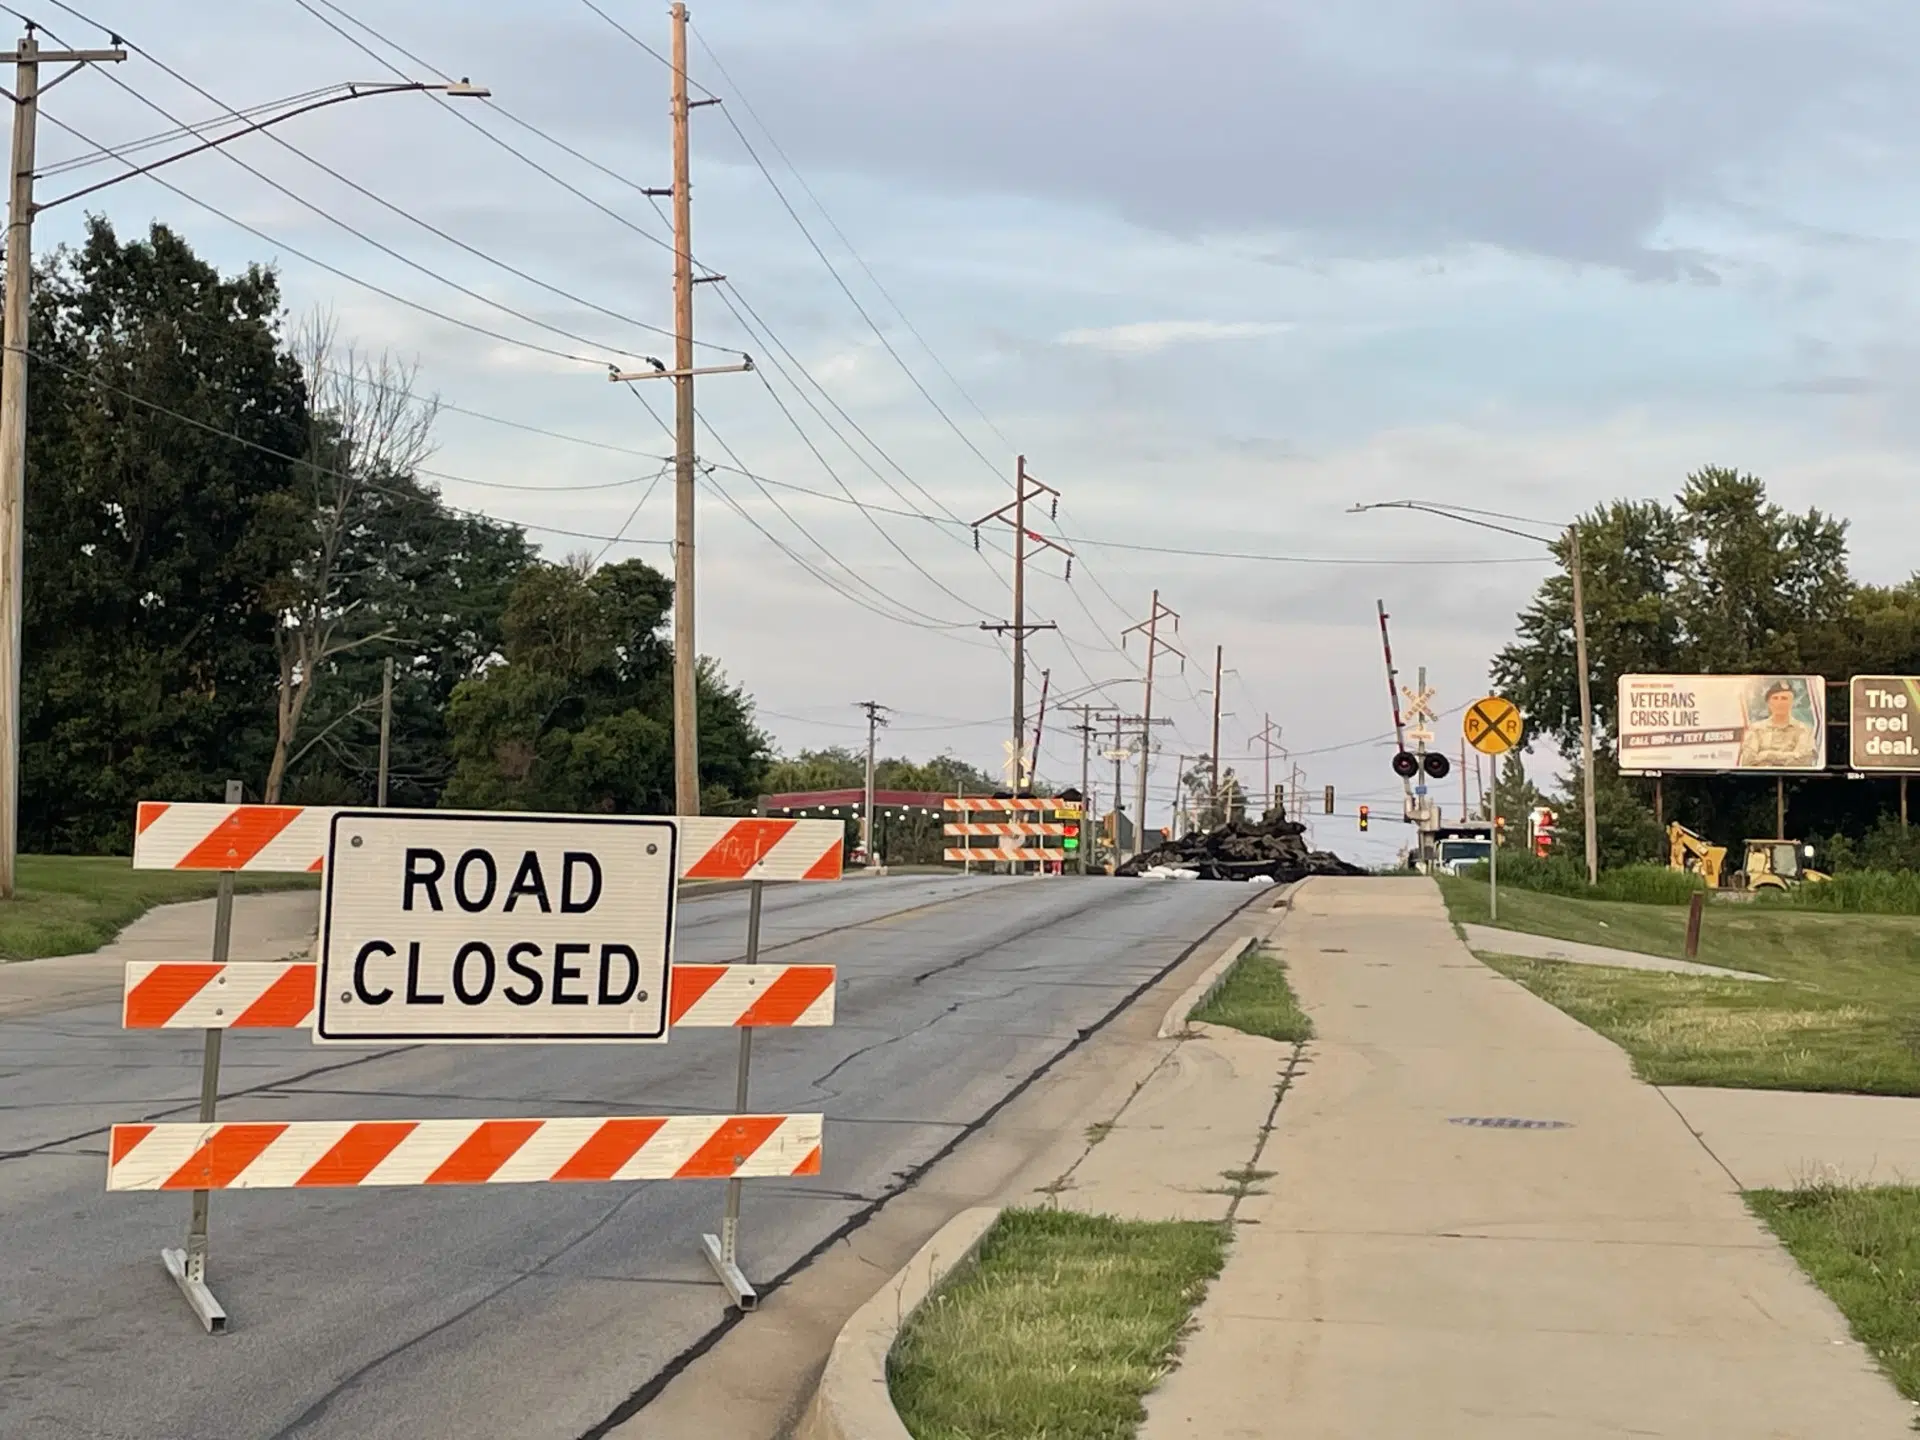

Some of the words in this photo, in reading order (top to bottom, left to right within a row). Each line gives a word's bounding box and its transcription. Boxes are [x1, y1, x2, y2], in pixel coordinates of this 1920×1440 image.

[1630, 692, 1696, 708] VETERANS
[1865, 689, 1908, 708] The
[1469, 719, 1480, 732] R
[1507, 720, 1517, 733] R
[1630, 711, 1670, 727] CRISIS
[1673, 711, 1700, 727] LINE
[1865, 713, 1908, 732] reel
[1865, 736, 1919, 755] deal.
[402, 848, 602, 913] ROAD
[353, 940, 640, 1005] CLOSED
